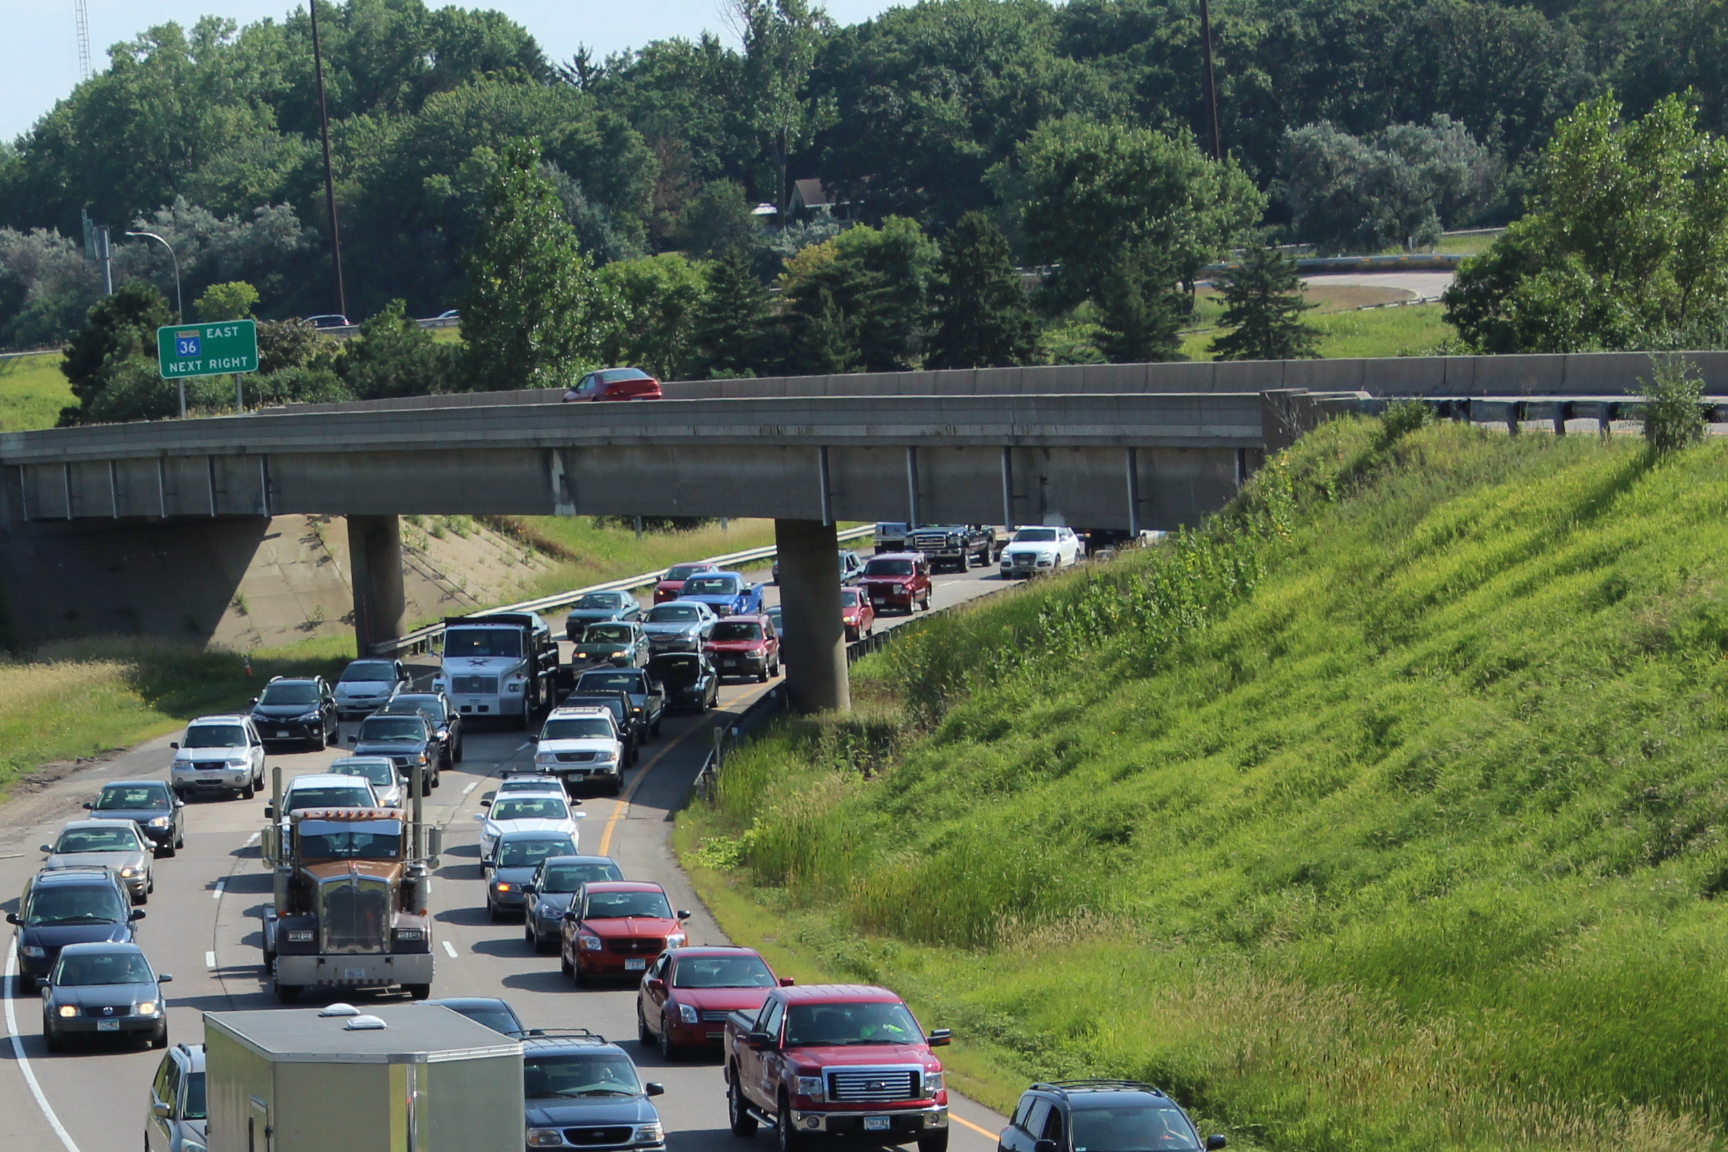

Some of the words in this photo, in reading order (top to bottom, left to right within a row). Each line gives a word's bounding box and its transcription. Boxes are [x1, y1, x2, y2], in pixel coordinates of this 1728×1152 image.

[206, 327, 238, 338] EAST
[180, 341, 196, 354] 36
[169, 361, 202, 373] NEXT
[209, 357, 248, 369] RIGHT
